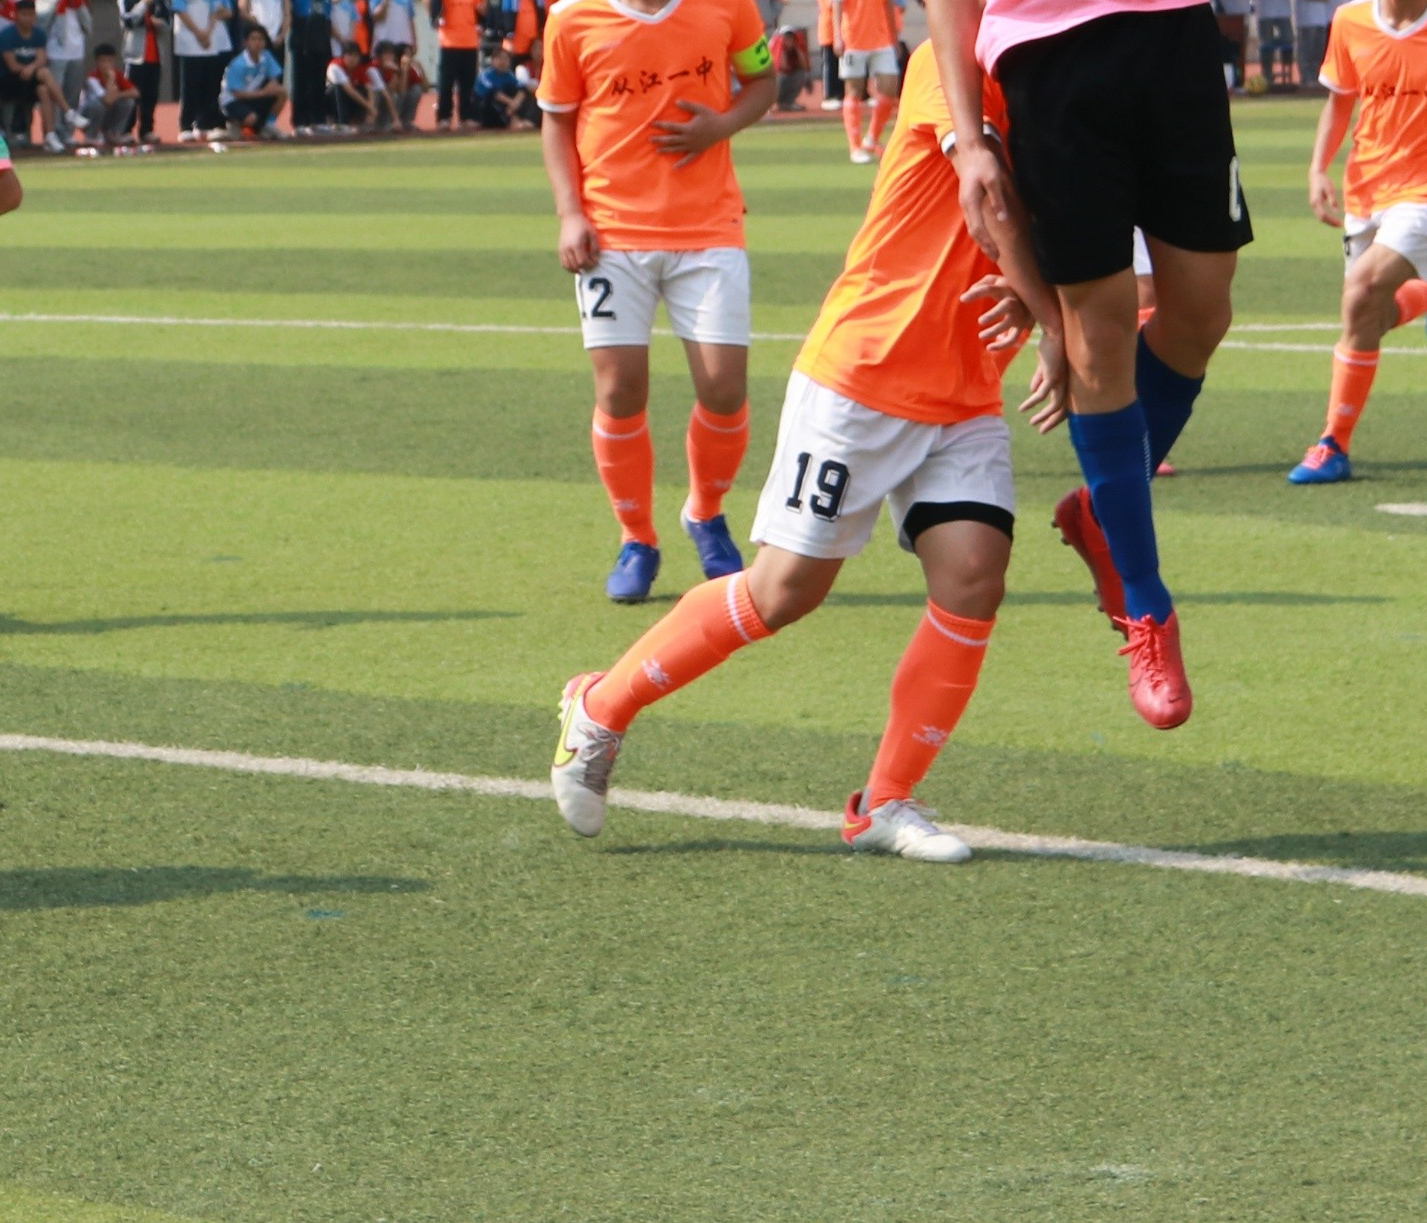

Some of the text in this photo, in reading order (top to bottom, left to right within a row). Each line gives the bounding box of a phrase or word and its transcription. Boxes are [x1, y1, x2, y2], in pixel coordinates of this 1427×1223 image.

[612, 56, 713, 96] 从江一中
[785, 451, 850, 523] 19
